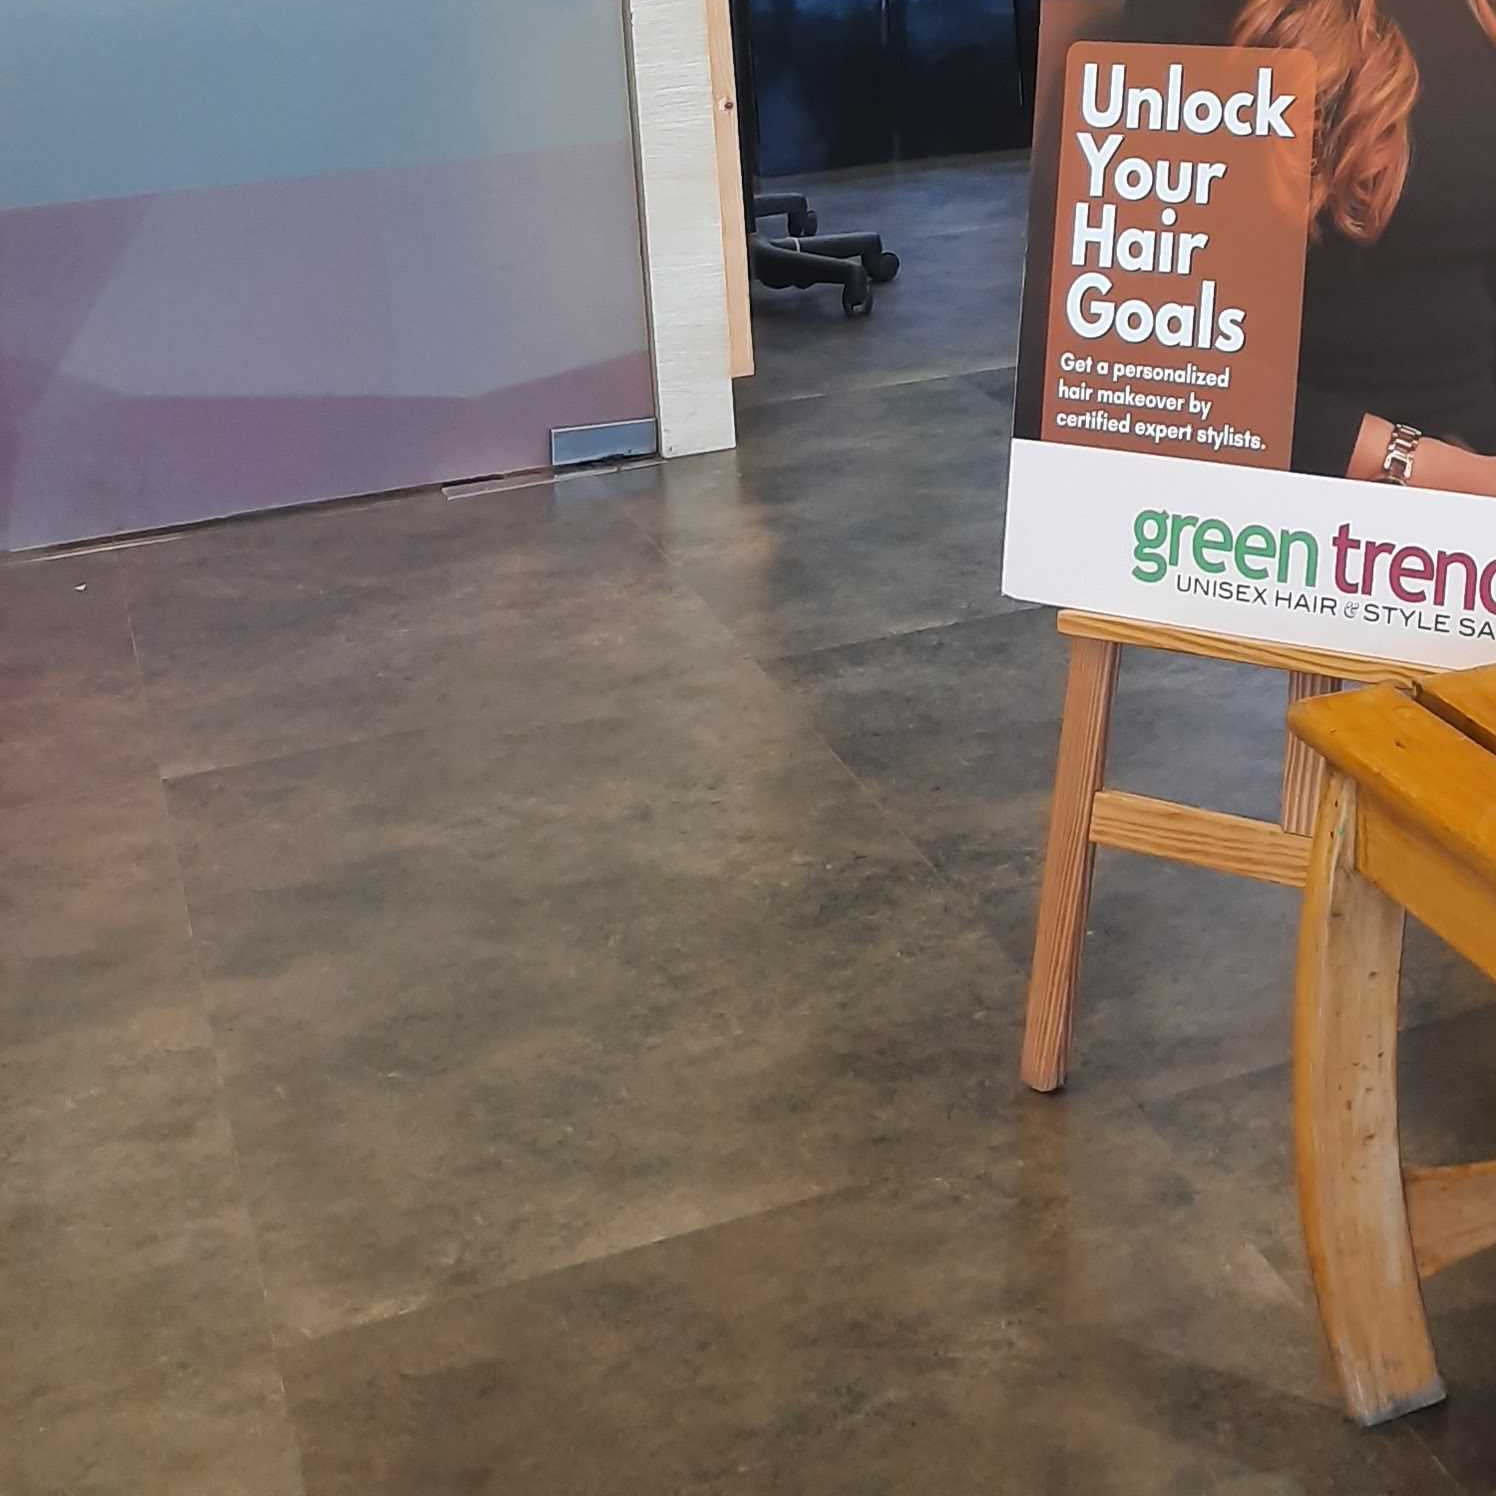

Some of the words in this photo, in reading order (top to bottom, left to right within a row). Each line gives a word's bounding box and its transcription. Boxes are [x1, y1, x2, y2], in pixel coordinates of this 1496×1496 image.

[1081, 63, 1297, 138] Unlock
[1076, 132, 1226, 205] Your
[1071, 202, 1210, 275] Hair
[1066, 272, 1246, 352] Goals
[1058, 380, 1093, 402] hair
[1097, 386, 1184, 412] makeover
[1189, 394, 1212, 418] by
[1060, 352, 1093, 372] Get
[1096, 361, 1109, 375] a
[1113, 363, 1230, 388] personalized
[1056, 410, 1131, 434] certified
[1135, 422, 1192, 445] expert
[1197, 426, 1267, 450] stylists.
[1131, 509, 1319, 588] green
[1176, 574, 1268, 605] UNISEX
[1274, 592, 1338, 616] HAIR
[1343, 602, 1361, 619] &
[1363, 604, 1450, 633] STYLE
